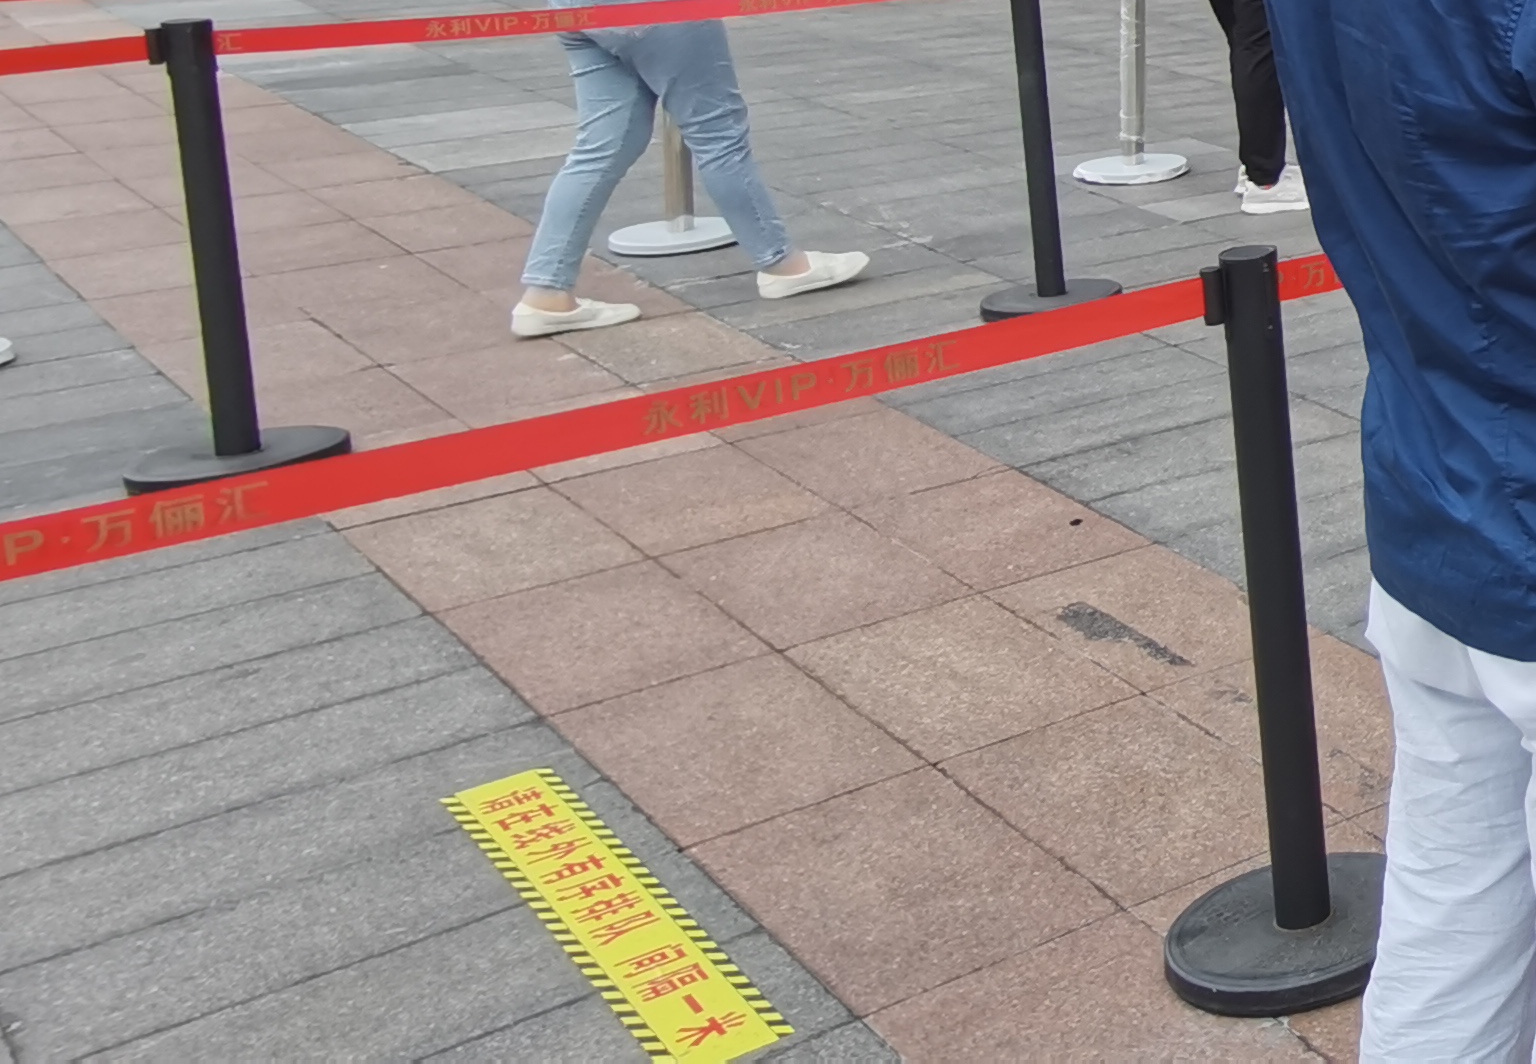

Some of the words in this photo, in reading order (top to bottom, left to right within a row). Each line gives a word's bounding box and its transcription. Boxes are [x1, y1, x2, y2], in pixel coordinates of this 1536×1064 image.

[478, 785, 662, 947] 请在线外有序排队
[612, 942, 748, 1048] 间隔一米
